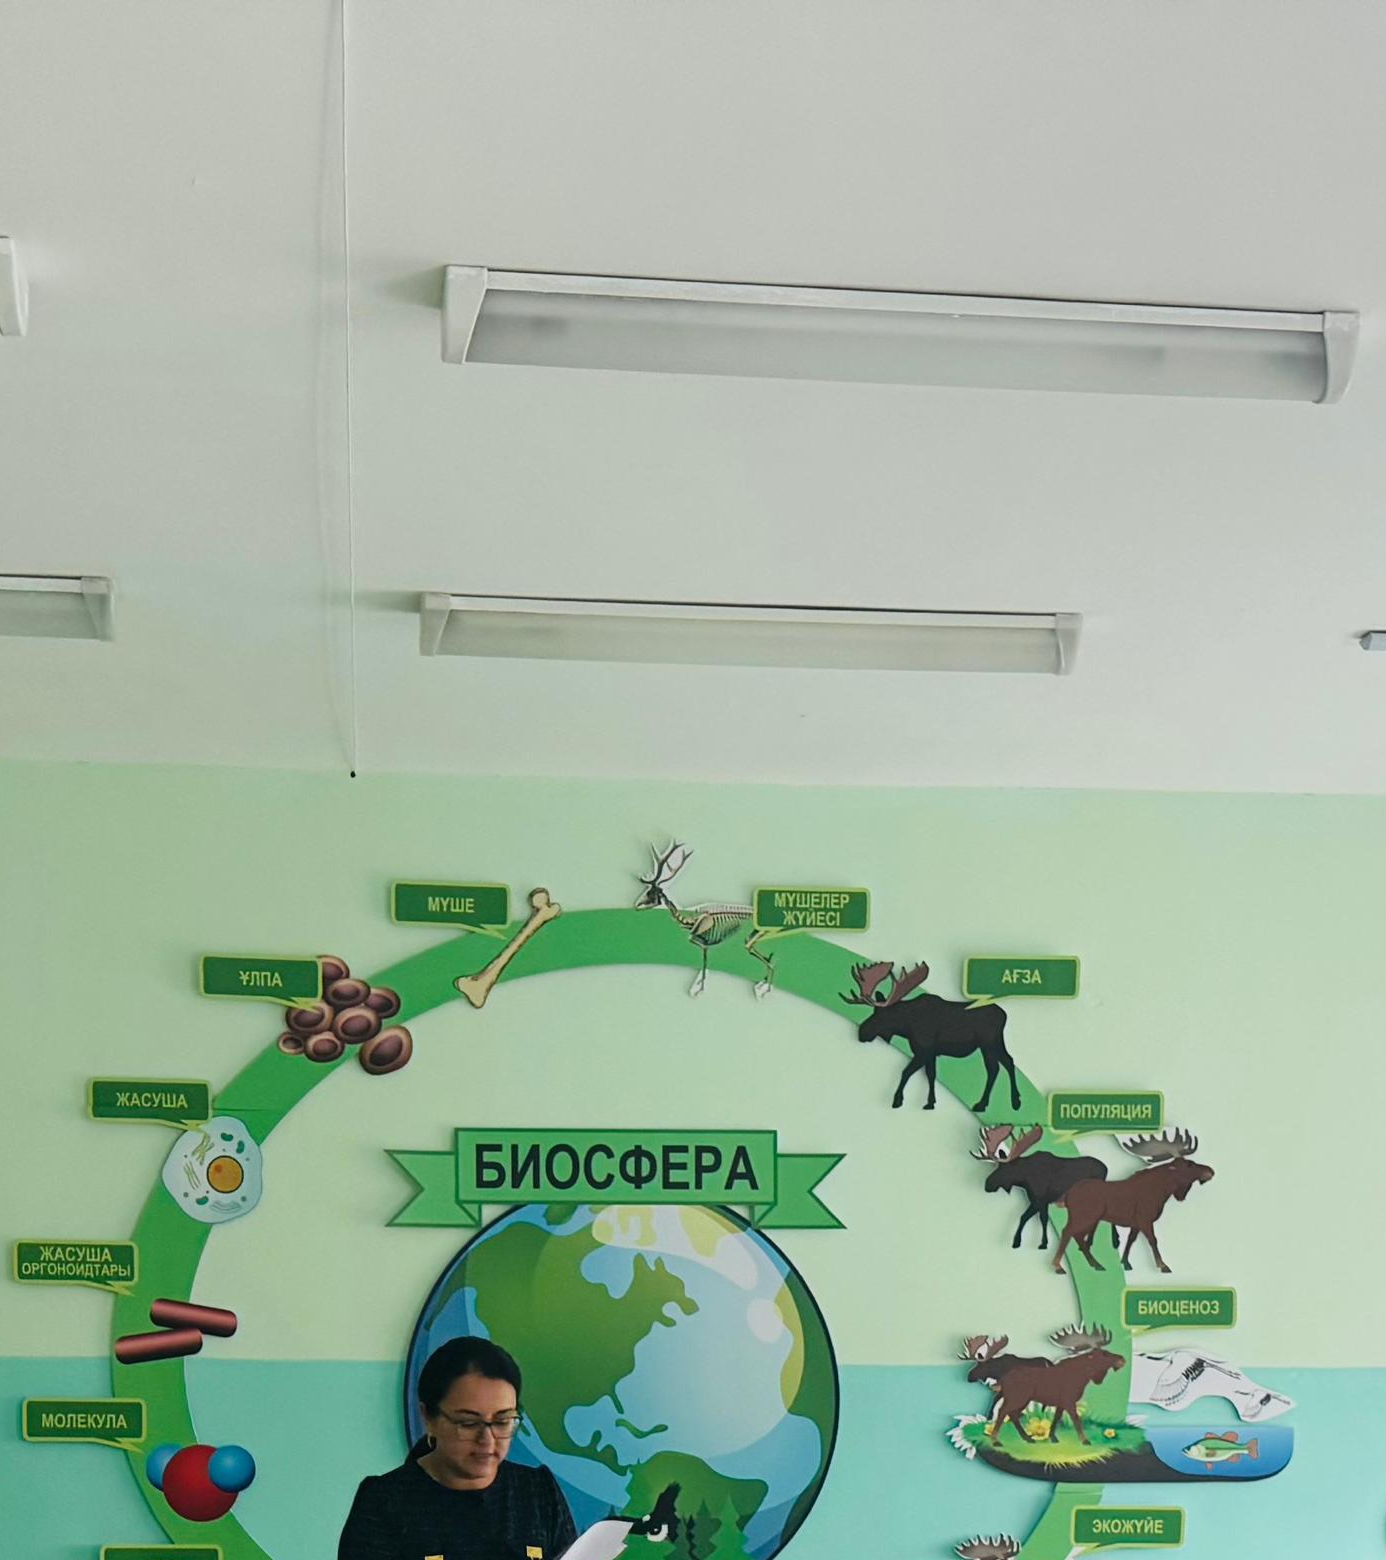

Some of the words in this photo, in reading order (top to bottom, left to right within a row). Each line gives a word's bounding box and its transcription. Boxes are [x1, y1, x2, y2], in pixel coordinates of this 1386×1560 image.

[1001, 968, 1042, 985] АҒЗА
[115, 1090, 189, 1110] ЖАСУША
[1060, 1102, 1152, 1121] ПОПУЛЯЦИЯ
[474, 1142, 760, 1192] БИОСФЕРА
[39, 1246, 113, 1262] ЖАСУША
[21, 1262, 131, 1278] ОРГОНОИДТАРЫ
[1138, 1298, 1220, 1317] БИОЦЕНОЗ
[41, 1413, 127, 1430] МОЛЕКУЛА
[1092, 1517, 1164, 1536] ЭКОЖҮЙЕ
